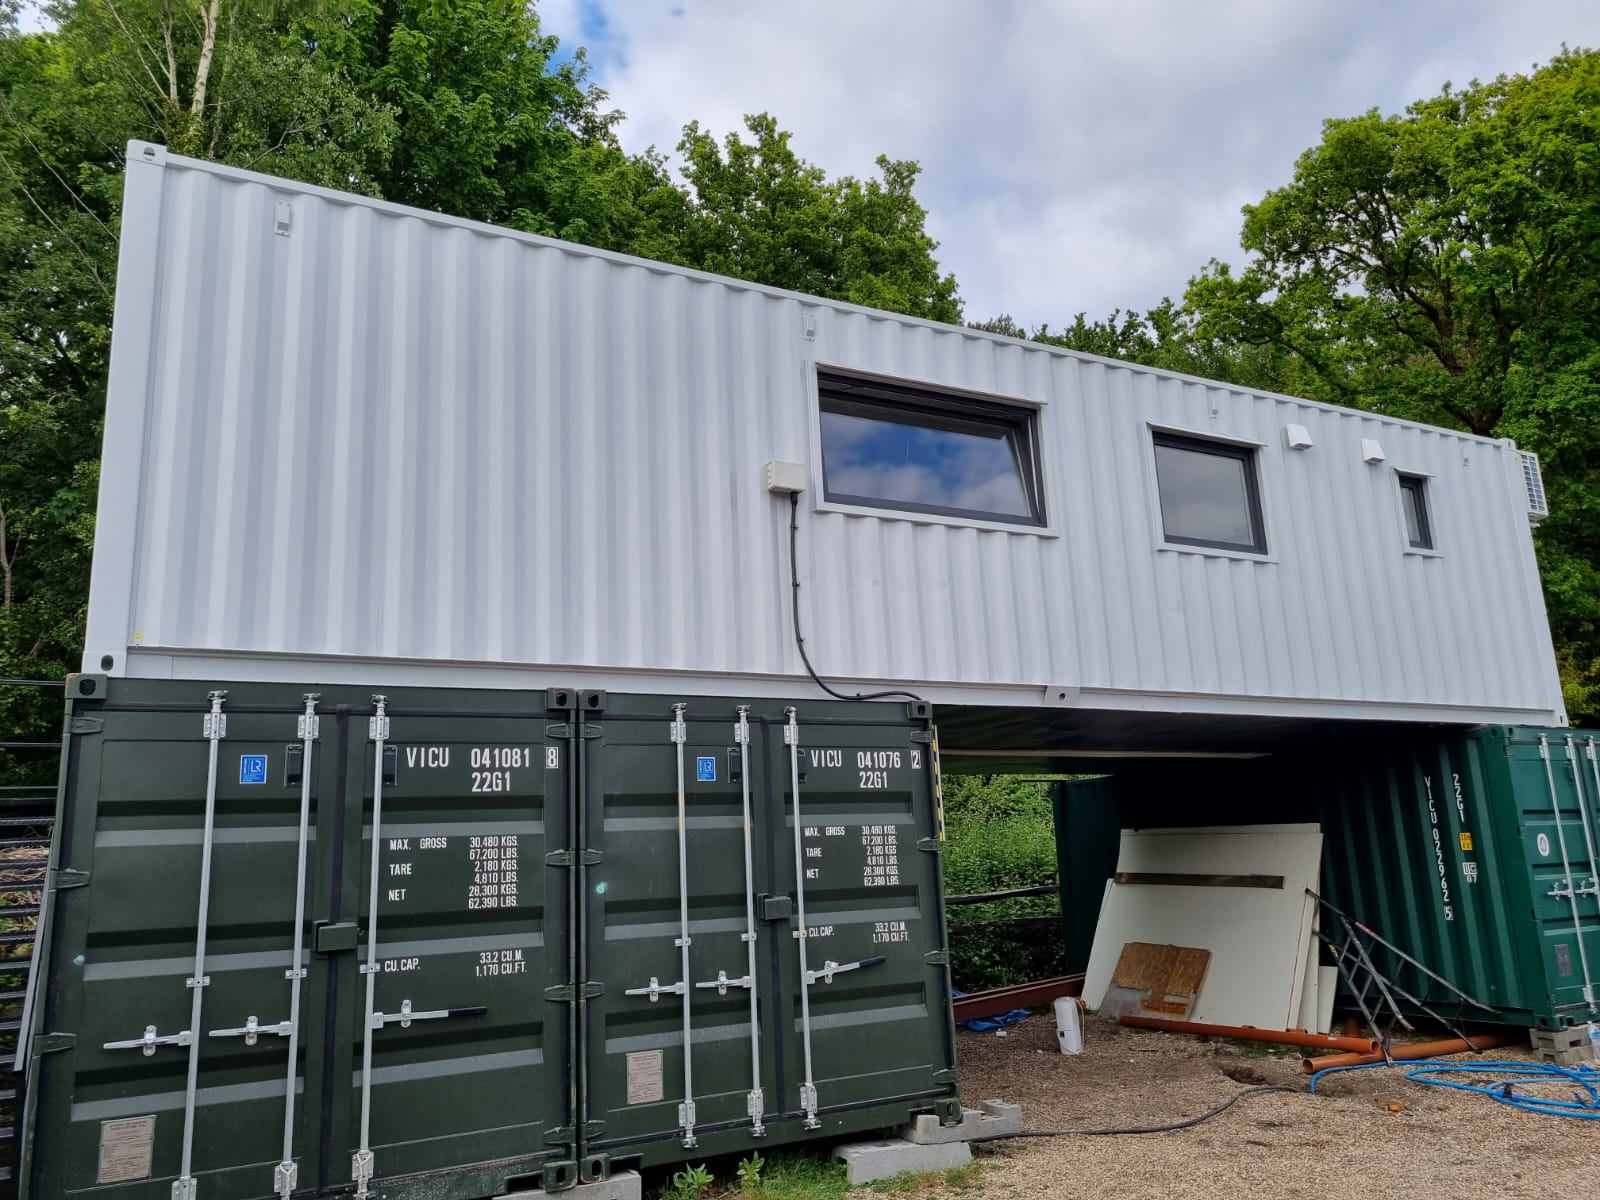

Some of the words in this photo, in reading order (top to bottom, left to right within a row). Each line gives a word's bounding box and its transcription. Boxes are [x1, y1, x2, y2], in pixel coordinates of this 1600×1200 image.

[406, 747, 449, 768] VICU
[471, 748, 530, 768] 041081
[547, 747, 557, 768] 8
[811, 750, 842, 768] VICU
[857, 752, 901, 769] 041076
[912, 751, 920, 768] 2
[471, 772, 511, 792] 22G1
[859, 772, 888, 788] 22G1
[1453, 773, 1464, 823] 22G1
[825, 826, 845, 836] GROSS
[1424, 775, 1438, 824] VICU
[1432, 828, 1450, 902] 022962
[389, 839, 411, 851] MAX.
[419, 837, 447, 849] GROSS
[805, 847, 823, 857] TARE
[389, 863, 412, 876] TARE
[806, 869, 820, 879] NET
[388, 889, 406, 901] NET
